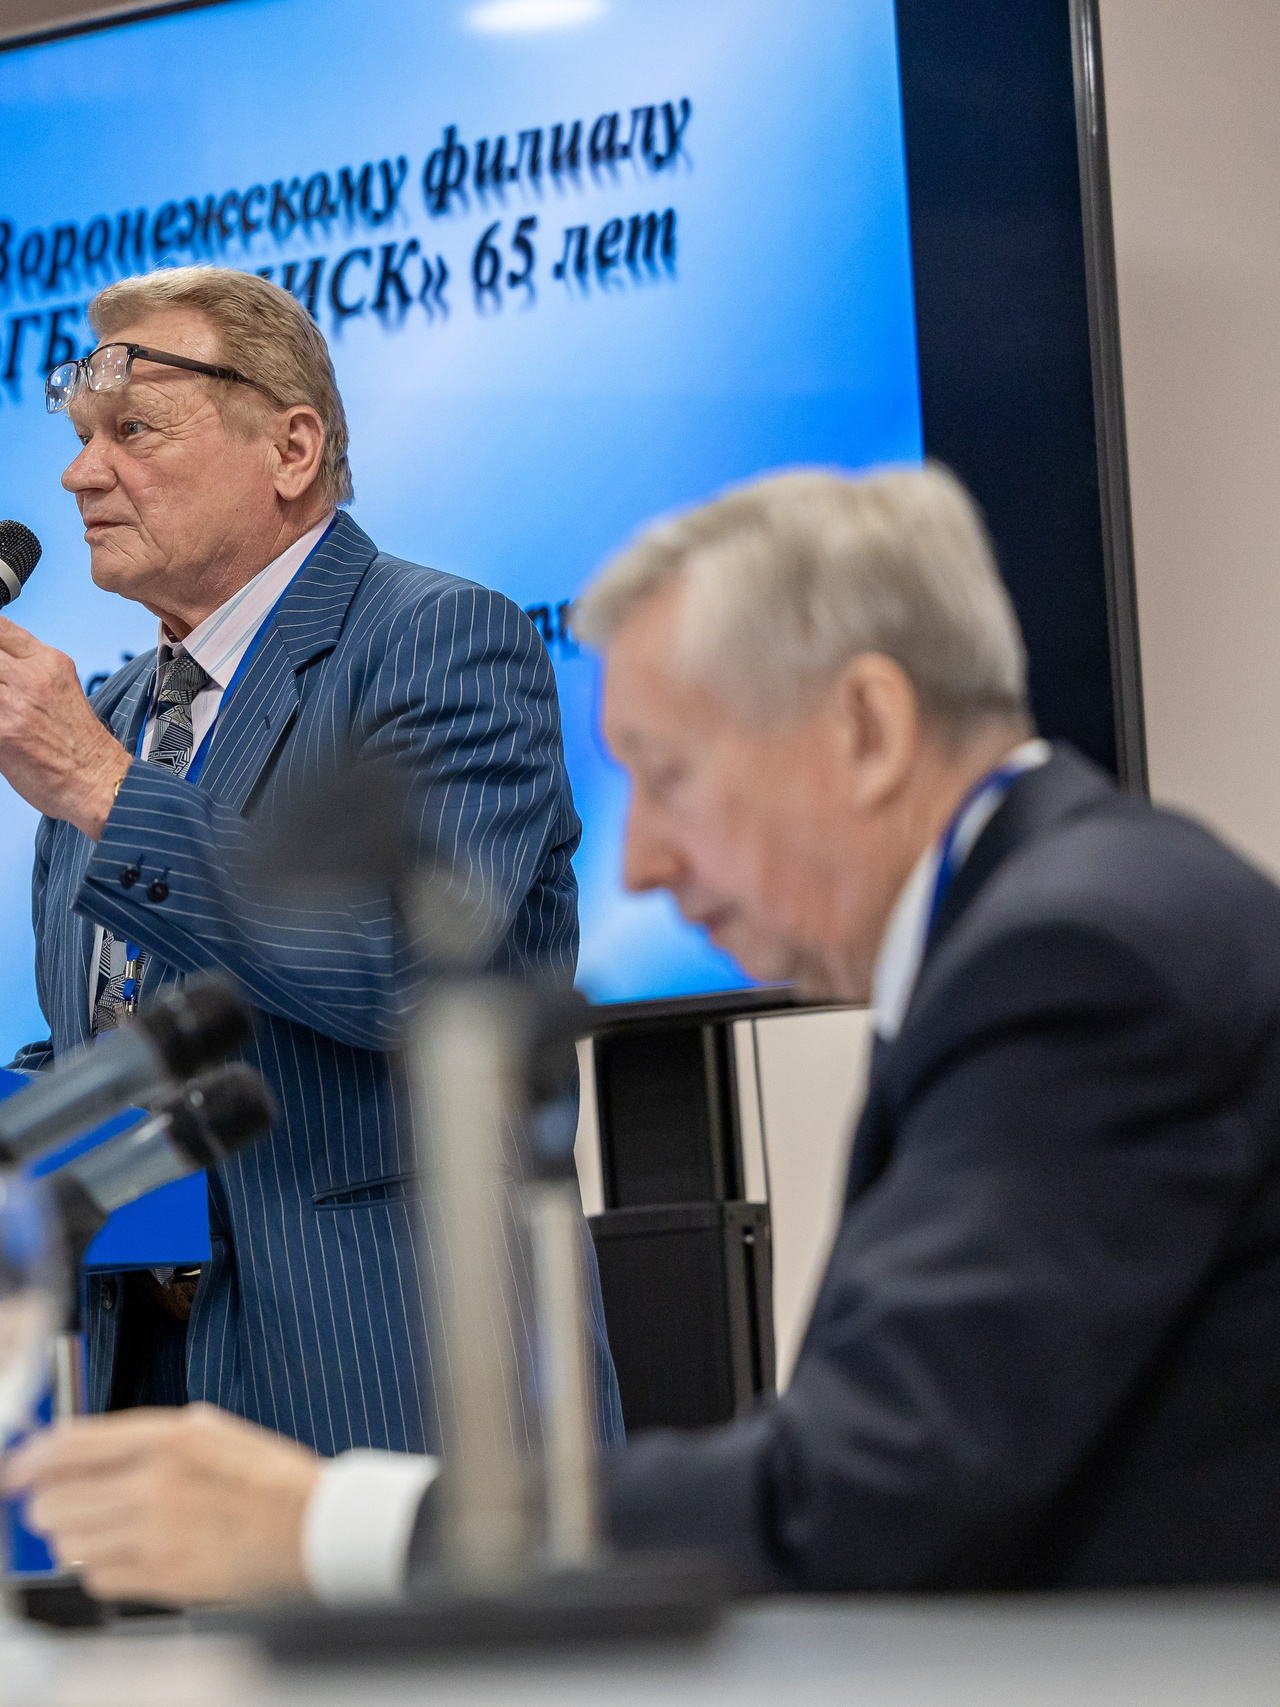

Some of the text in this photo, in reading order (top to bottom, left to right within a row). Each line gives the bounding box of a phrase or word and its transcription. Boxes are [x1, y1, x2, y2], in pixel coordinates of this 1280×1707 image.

[422, 96, 692, 214] филиалу
[256, 238, 450, 320] ИСК»
[473, 215, 538, 288] 65
[553, 207, 677, 280] лет
